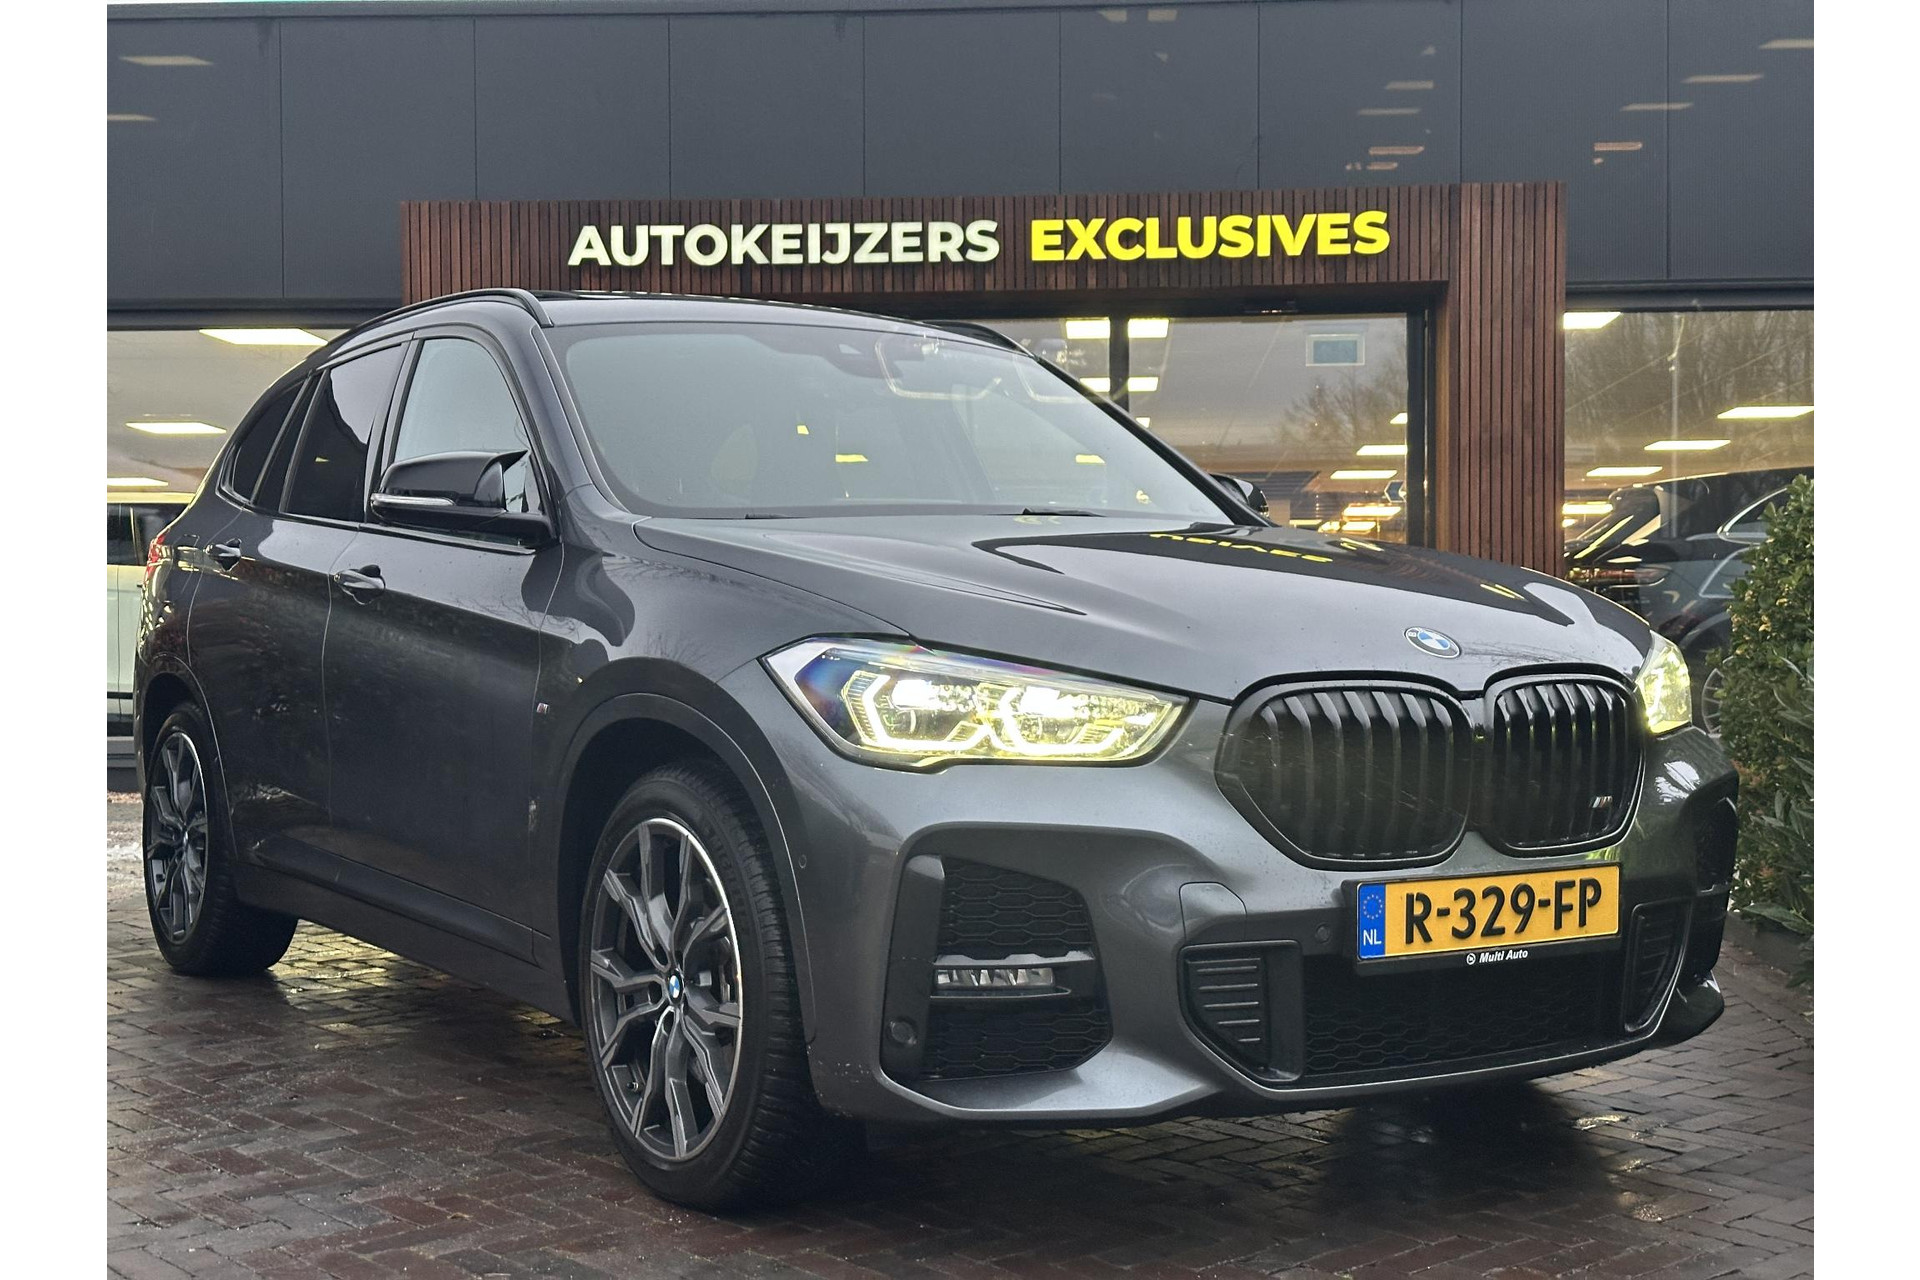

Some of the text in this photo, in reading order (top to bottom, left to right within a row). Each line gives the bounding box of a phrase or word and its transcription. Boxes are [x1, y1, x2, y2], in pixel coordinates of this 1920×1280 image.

[568, 210, 1391, 267] AUTOKEIJZERS EXCLUSIVES
[1404, 877, 1602, 945] R-329-FP
[1363, 928, 1382, 947] NL
[1479, 949, 1529, 963] Multi Auto
